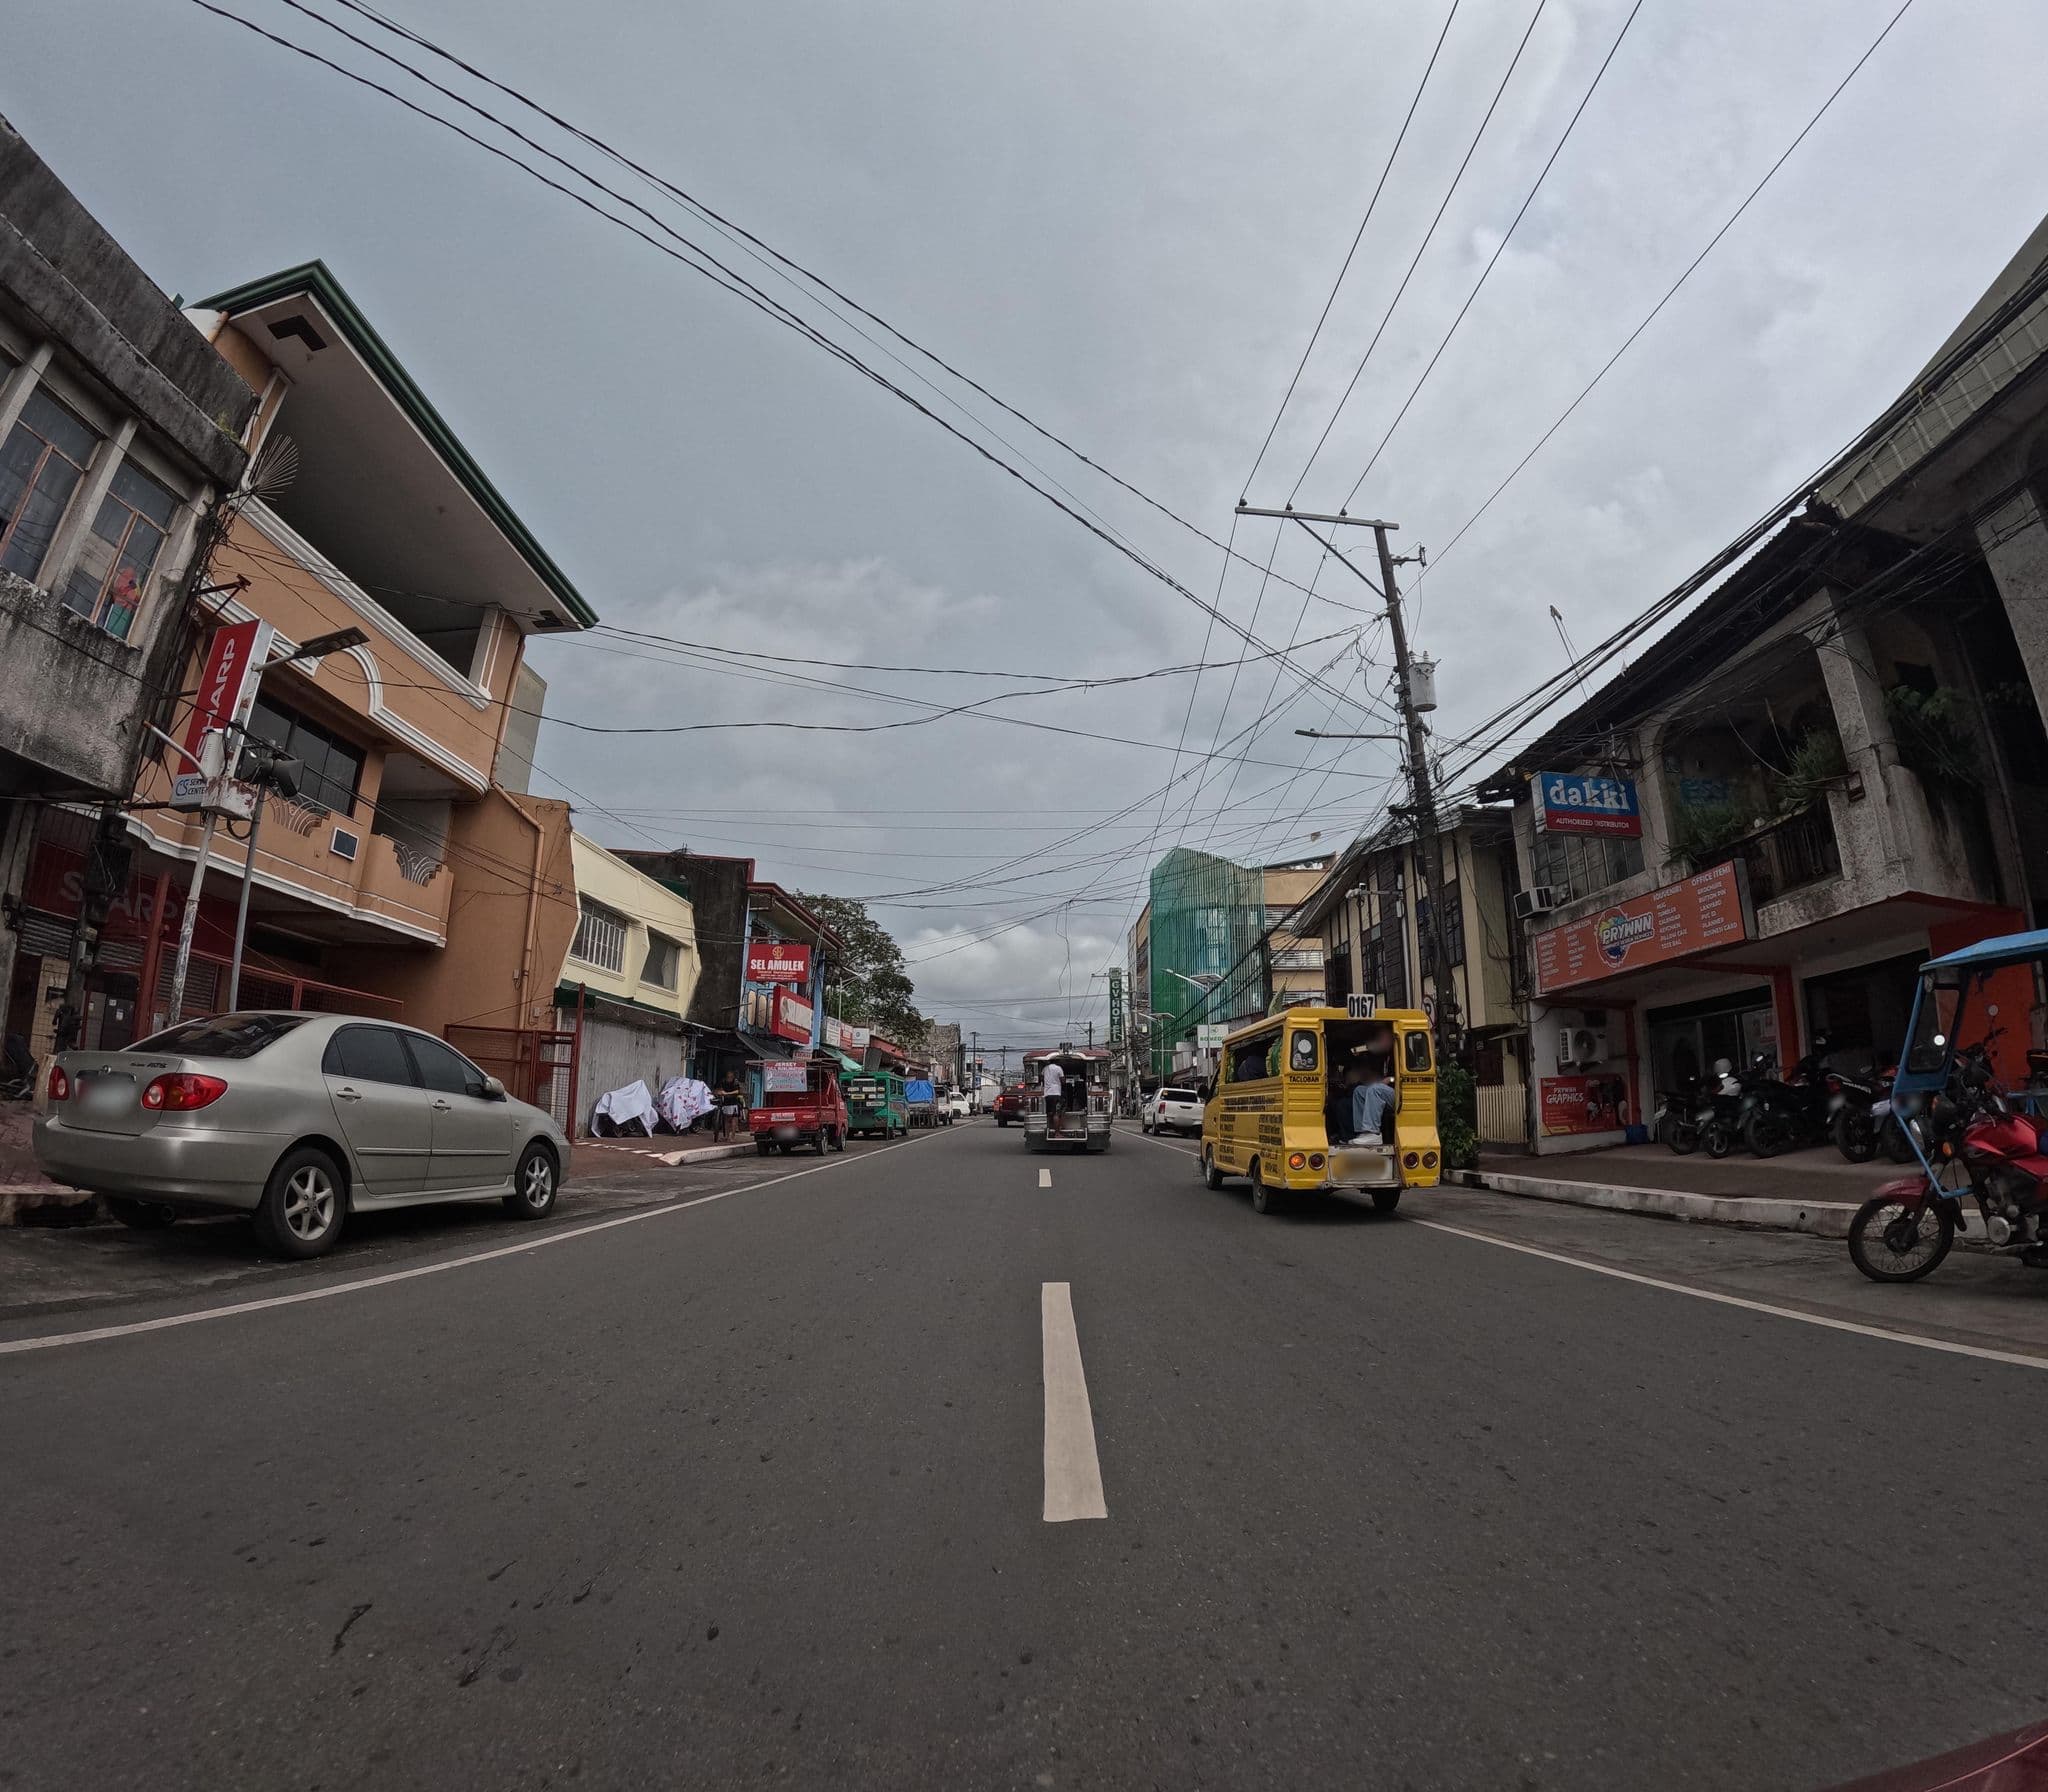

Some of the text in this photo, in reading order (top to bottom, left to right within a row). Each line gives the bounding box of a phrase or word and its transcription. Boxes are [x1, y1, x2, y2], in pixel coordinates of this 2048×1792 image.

[188, 787, 206, 795] CENTE
[1556, 818, 1630, 829] AUTHORIZED DISTRIBUTOR
[1691, 871, 1714, 886] OFFICE
[60, 871, 179, 921] SARP
[1603, 915, 1651, 945] PRYWNN
[751, 959, 804, 971] SEL AMULEK
[1111, 981, 1121, 1042] GV HOTEL
[1349, 996, 1373, 1018] 0167
[1546, 1092, 1584, 1104] GRAPHICS
